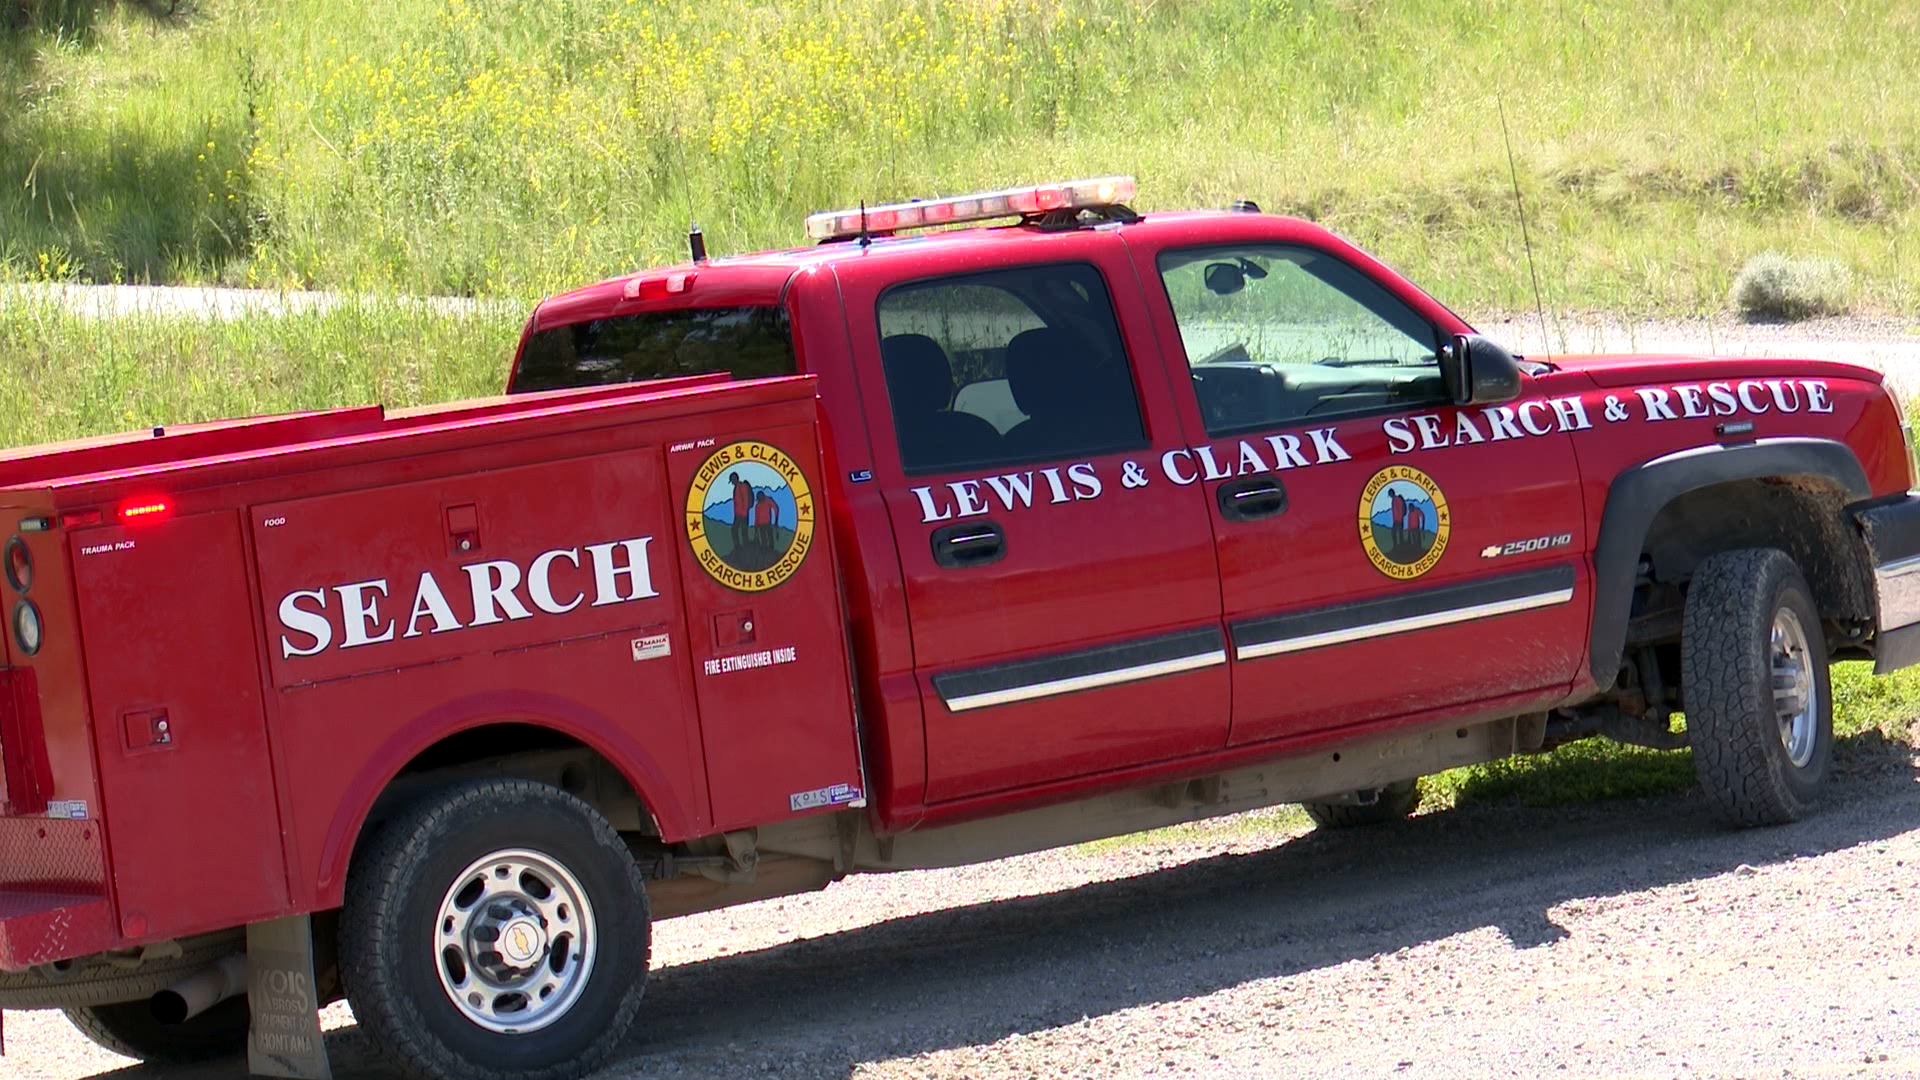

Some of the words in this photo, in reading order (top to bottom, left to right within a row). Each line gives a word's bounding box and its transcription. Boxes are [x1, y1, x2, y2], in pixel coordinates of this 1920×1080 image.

[670, 441, 695, 453] AIRWAY
[697, 438, 716, 449] PACK
[912, 462, 1103, 524] LEWIS
[1120, 460, 1150, 490] &
[1161, 426, 1353, 485] CLARK
[1382, 396, 1593, 455] SEARCH
[1603, 393, 1630, 423] &
[1635, 379, 1835, 422] RESCUE
[695, 451, 731, 492] LEWIS
[735, 445, 745, 460] &
[750, 444, 799, 483] CLARK
[850, 470, 872, 482] LS
[1363, 471, 1388, 504] LEWIS
[1389, 468, 1398, 479] &
[1400, 467, 1438, 497] CLARK
[264, 517, 286, 528] FOOD
[81, 543, 113, 556] TRAUMA
[114, 540, 136, 551] PACK
[700, 548, 752, 588] SEARCH
[755, 573, 766, 588] &
[767, 531, 810, 585] RESCUE
[1368, 546, 1405, 577] SEARCH
[1406, 565, 1414, 577] &
[1415, 533, 1447, 574] RESCUE
[1503, 536, 1550, 556] 2500
[1551, 533, 1572, 547] HD
[278, 535, 660, 659] SEARCH
[704, 658, 721, 676] FIRE
[721, 651, 772, 674] EXTINGUISHER
[772, 646, 797, 665] INSIDE
